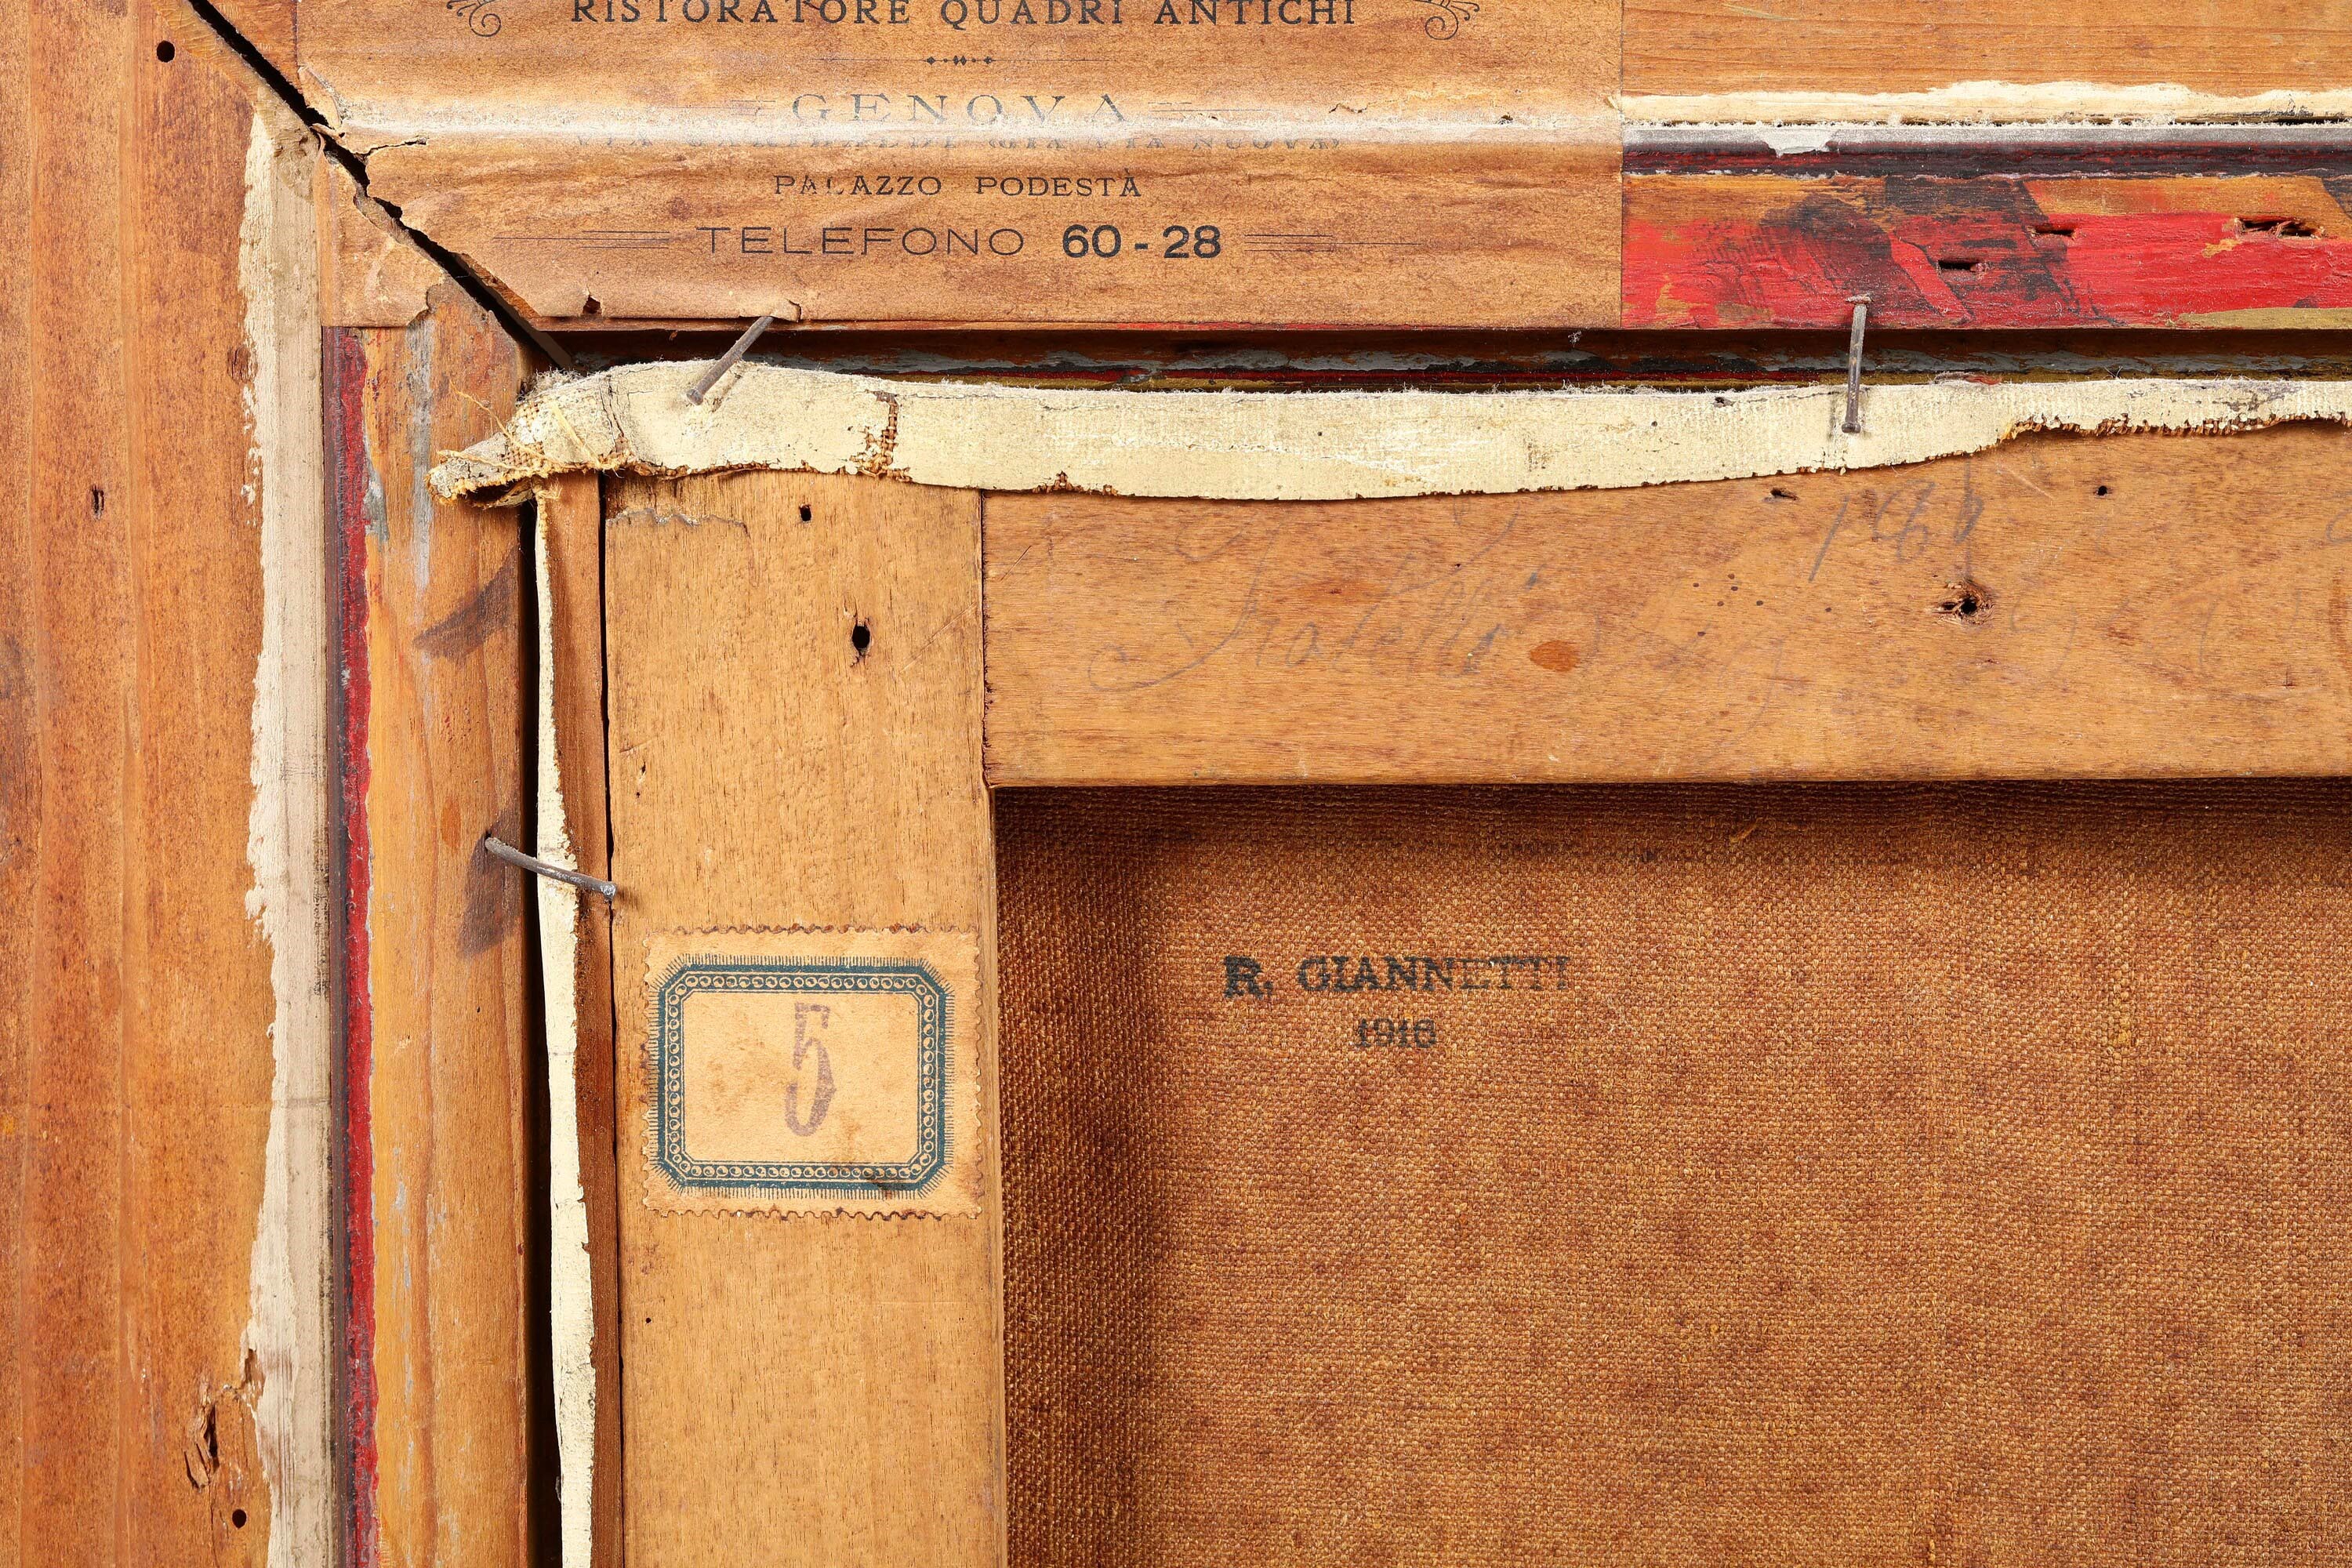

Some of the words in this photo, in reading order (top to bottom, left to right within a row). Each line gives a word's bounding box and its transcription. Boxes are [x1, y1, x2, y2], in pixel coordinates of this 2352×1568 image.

[571, 0, 911, 24] RISTORATORE
[940, 0, 1122, 30] QUADRI
[1153, 0, 1356, 25] ANTICHI
[792, 91, 1126, 125] GENOVA
[773, 174, 942, 195] PALAZZO
[975, 168, 1142, 198] PODESTÀ
[695, 226, 1025, 256] TELEFONO
[1295, 954, 1569, 993] GIANNETTI
[784, 1001, 837, 1137] 5
